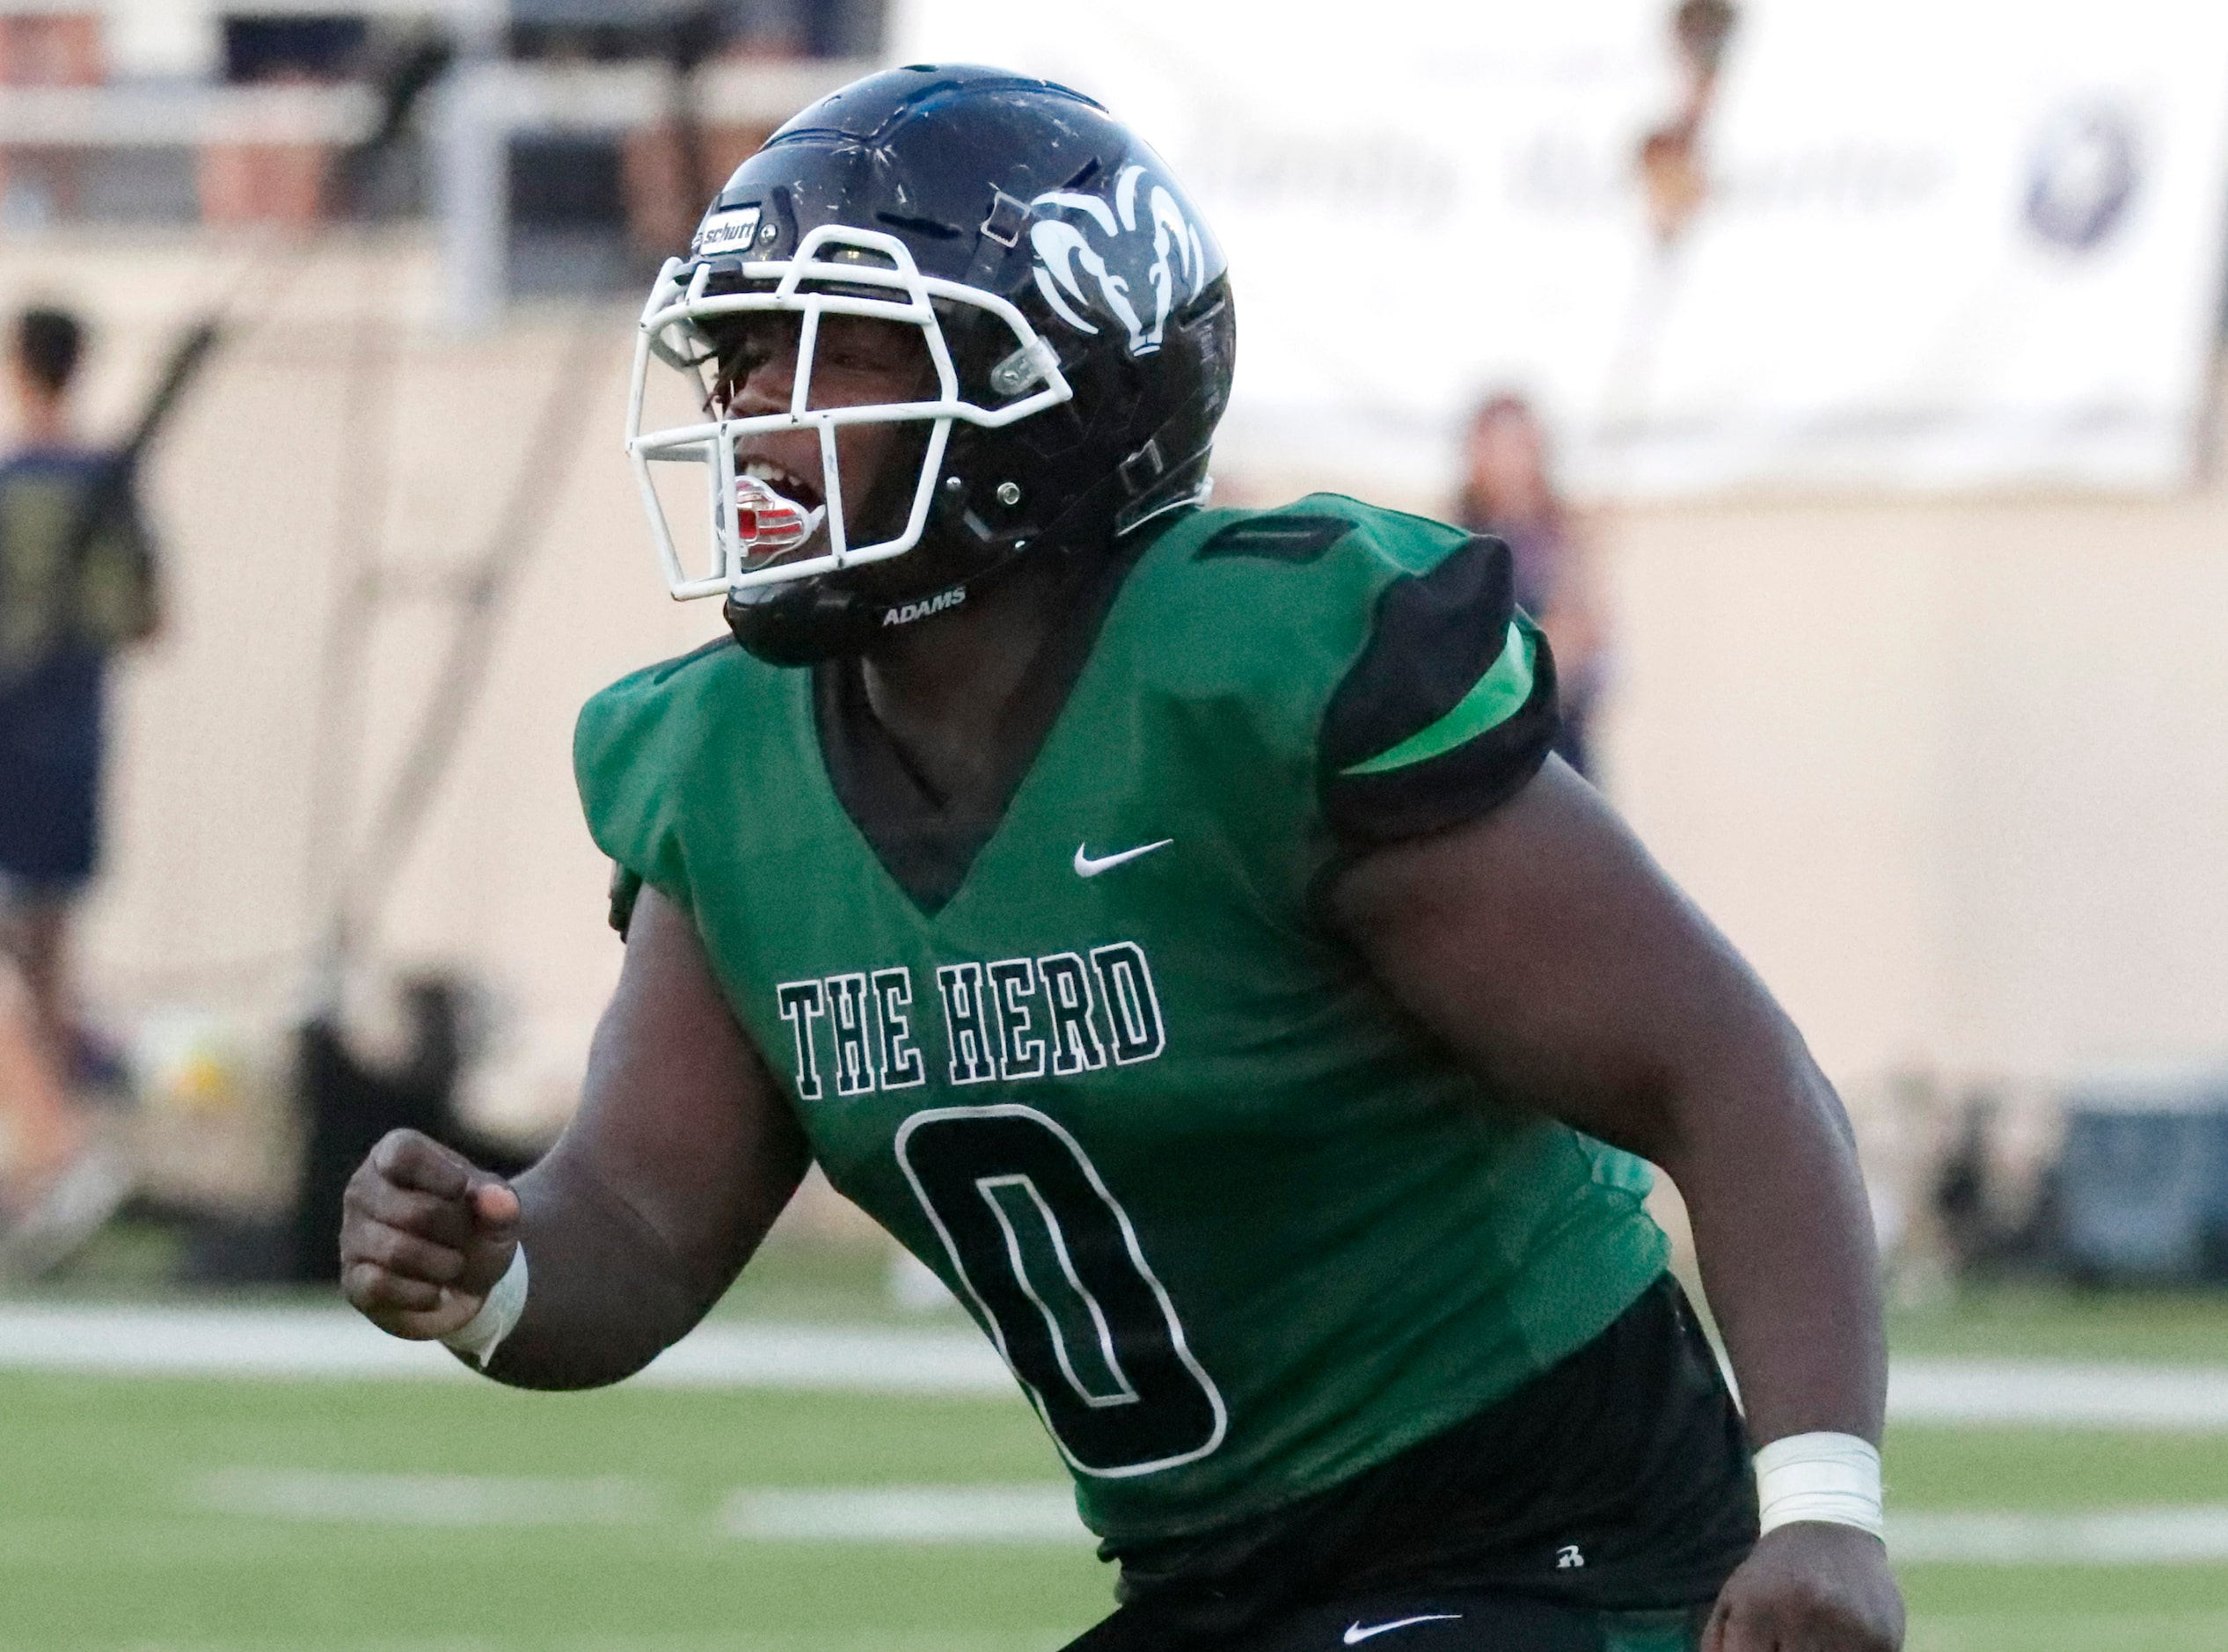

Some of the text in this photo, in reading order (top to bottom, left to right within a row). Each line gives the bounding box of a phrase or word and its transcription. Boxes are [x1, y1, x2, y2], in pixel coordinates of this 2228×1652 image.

[881, 586, 966, 626] ADAMS
[777, 940, 1166, 1100] THE HERD
[895, 1103, 1228, 1479] 0
